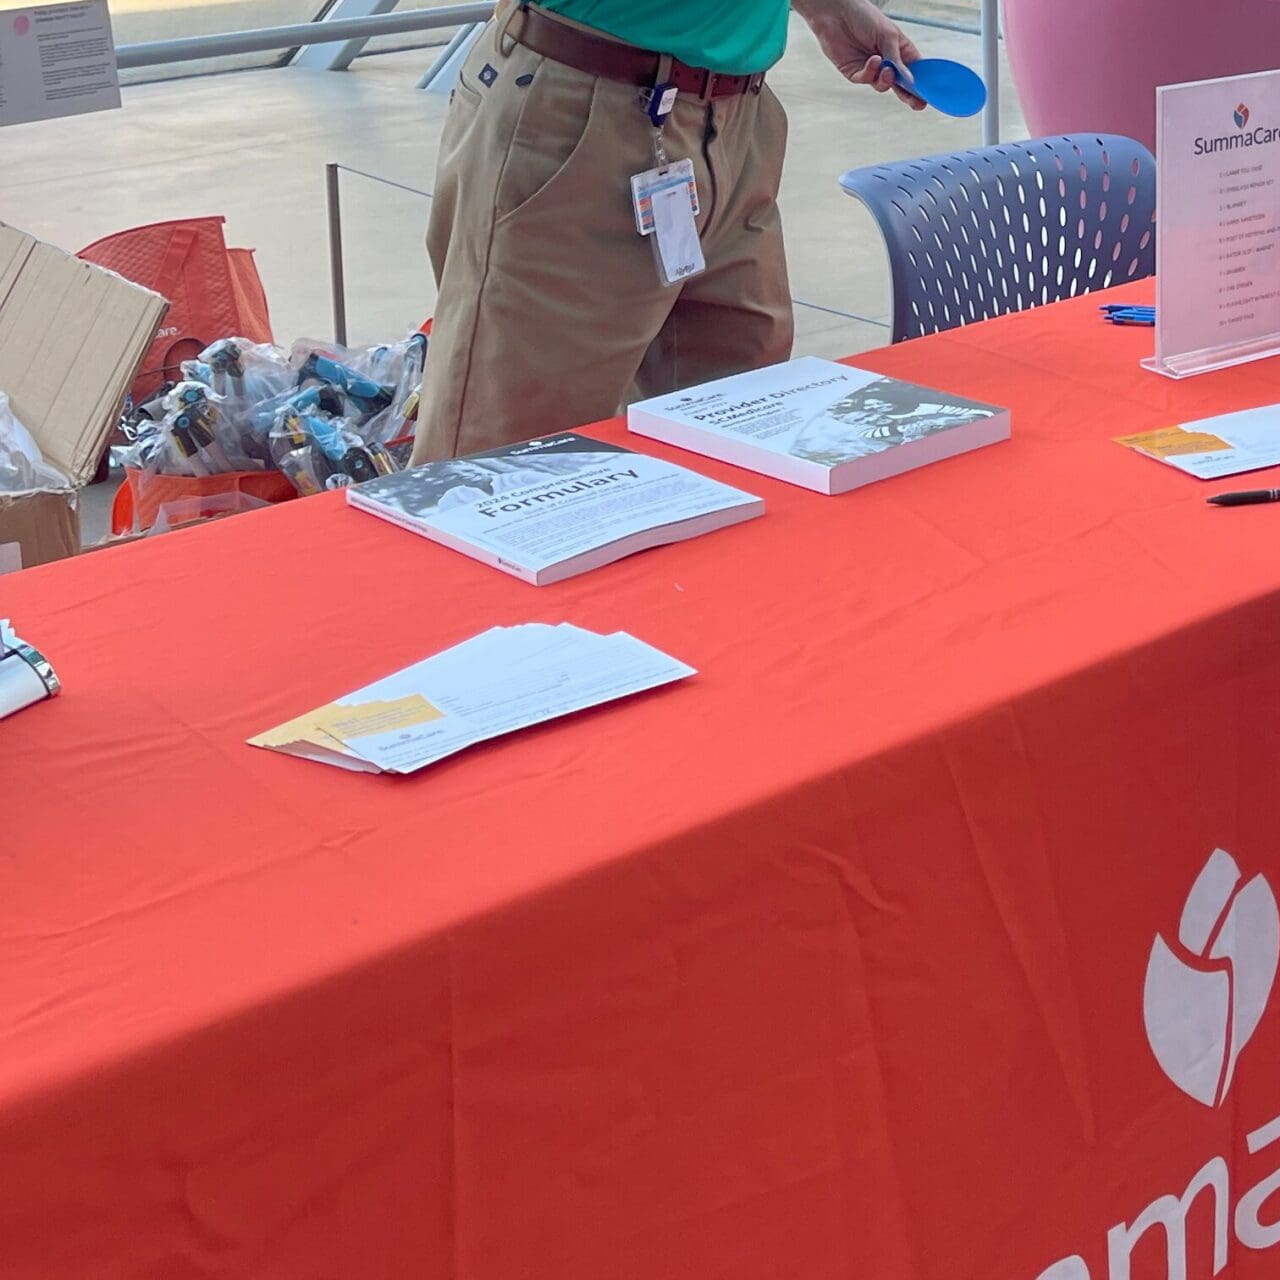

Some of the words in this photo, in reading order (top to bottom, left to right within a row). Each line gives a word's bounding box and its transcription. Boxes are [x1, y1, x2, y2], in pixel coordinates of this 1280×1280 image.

[693, 396, 768, 421] Provider
[769, 374, 849, 399] Directory
[478, 469, 639, 518] Formulary
